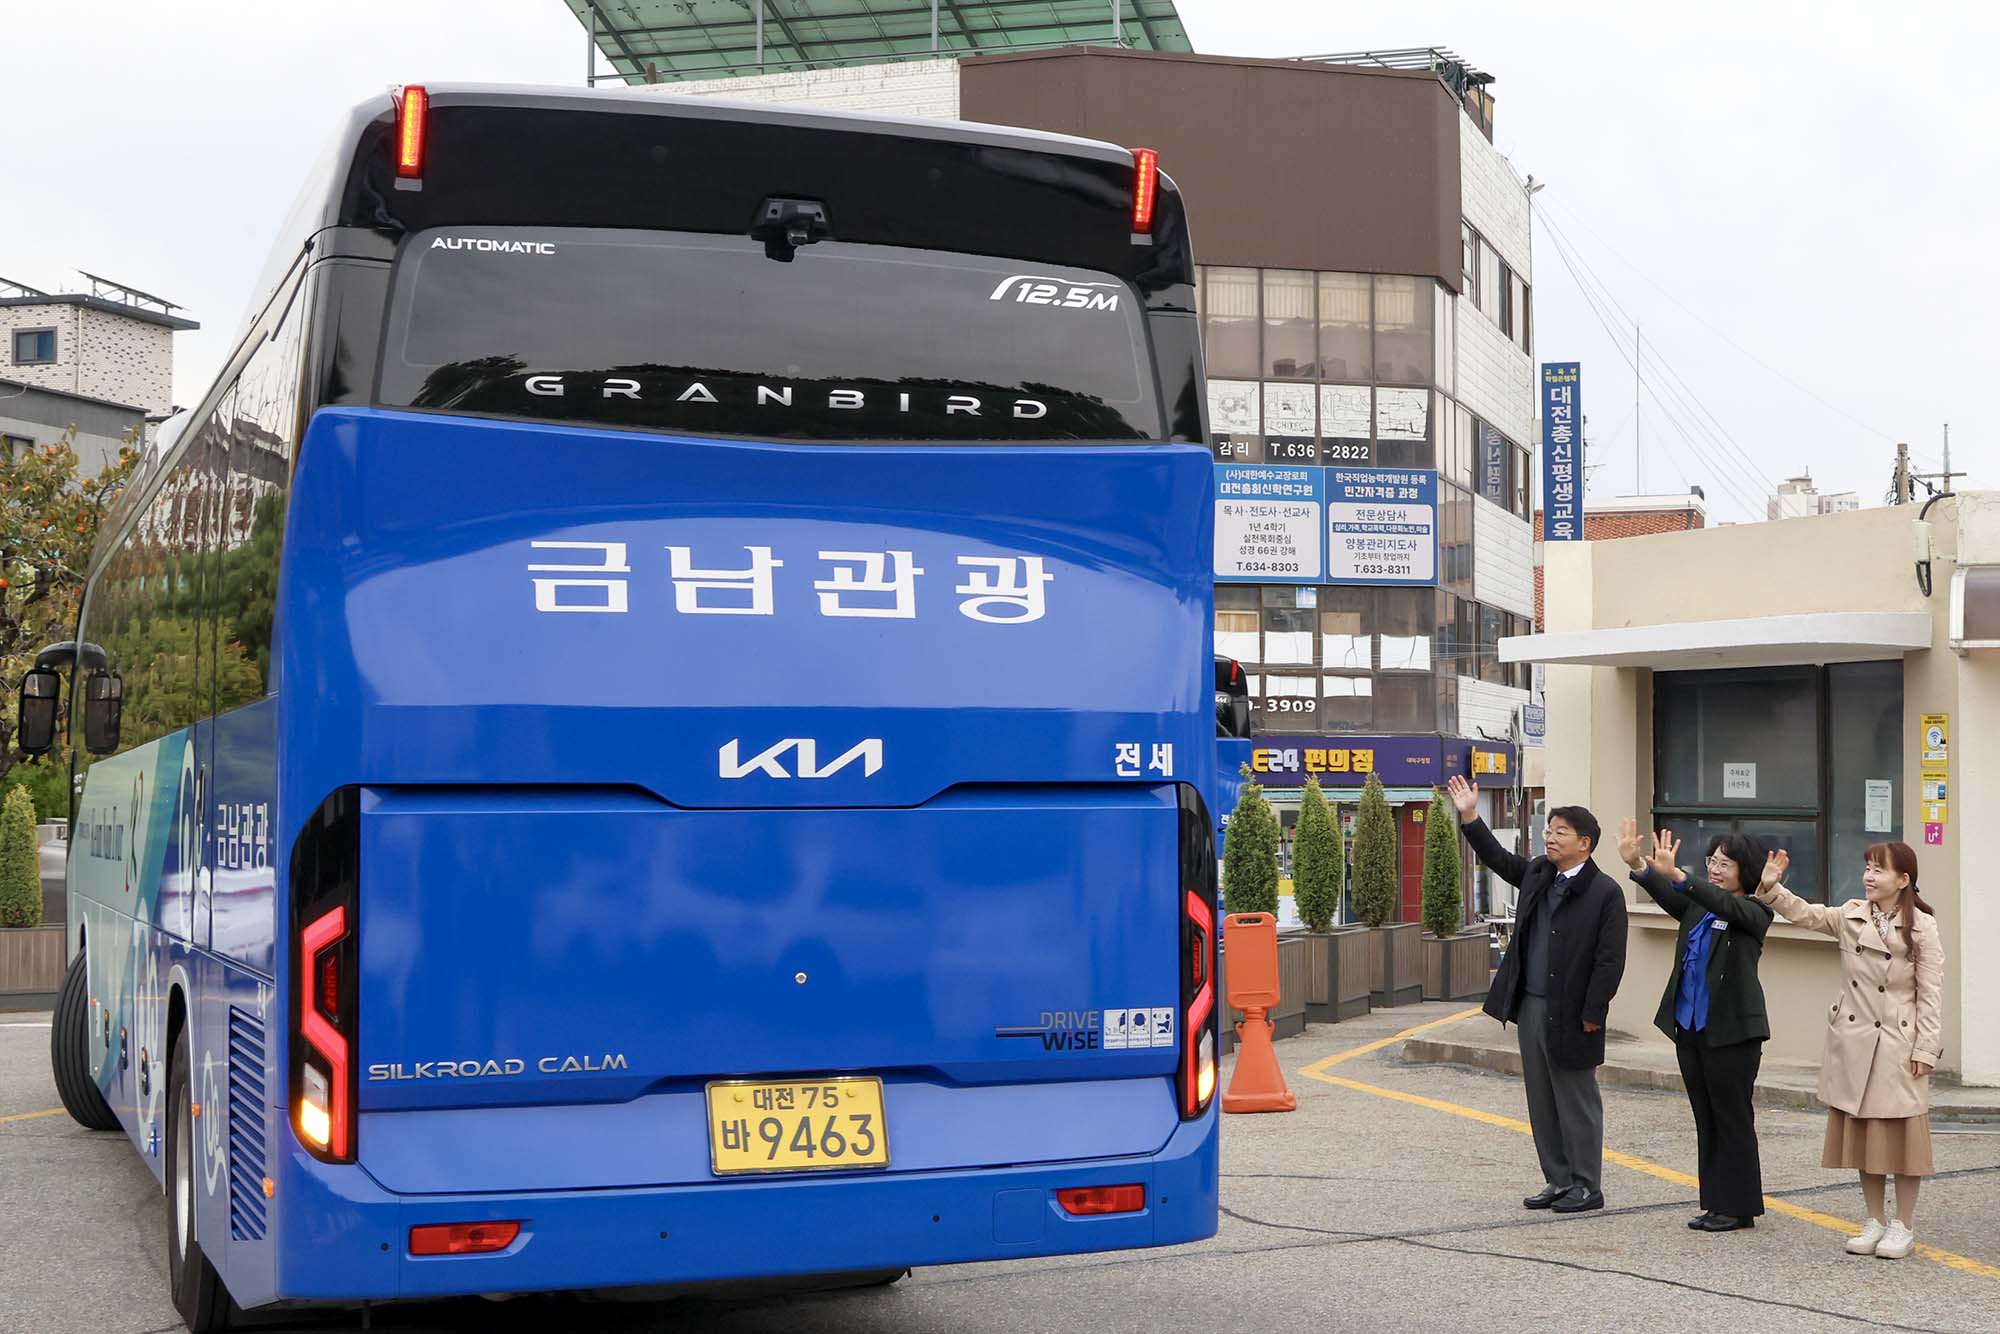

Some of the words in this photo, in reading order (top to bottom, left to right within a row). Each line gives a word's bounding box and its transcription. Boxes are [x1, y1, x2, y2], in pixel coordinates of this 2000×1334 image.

[430, 237, 556, 255] AUTOMATIC
[1015, 283, 1119, 312] 12.5M
[523, 375, 1048, 420] GRANBIRD
[1335, 472, 1409, 485] 한국직업능력개발원
[1220, 482, 1313, 497] 대전총회신학연구원
[1344, 486, 1395, 499] 민간자격증
[1398, 487, 1419, 499] 과정
[1355, 509, 1407, 522] 전문상담사
[1249, 523, 1261, 532] 1년
[1263, 523, 1286, 532] 4학기
[1239, 546, 1255, 556] 성경
[1257, 546, 1278, 556] 66권
[1345, 538, 1417, 551] 양봉관리지도사
[1236, 562, 1299, 572] T.634-8303
[1353, 564, 1411, 574] T.633-8311
[527, 540, 1055, 625] 금남관광
[1266, 698, 1317, 713] 3909
[718, 737, 884, 779] KIA
[1113, 742, 1174, 778] 전세
[1303, 748, 1375, 773] 편의점
[217, 802, 268, 873] 금남관광
[1040, 1010, 1099, 1029] DRIVE
[368, 1058, 525, 1081] SILKROAD
[538, 1053, 628, 1073] CALM
[752, 1087, 795, 1111] 대전
[801, 1086, 840, 1109] 75
